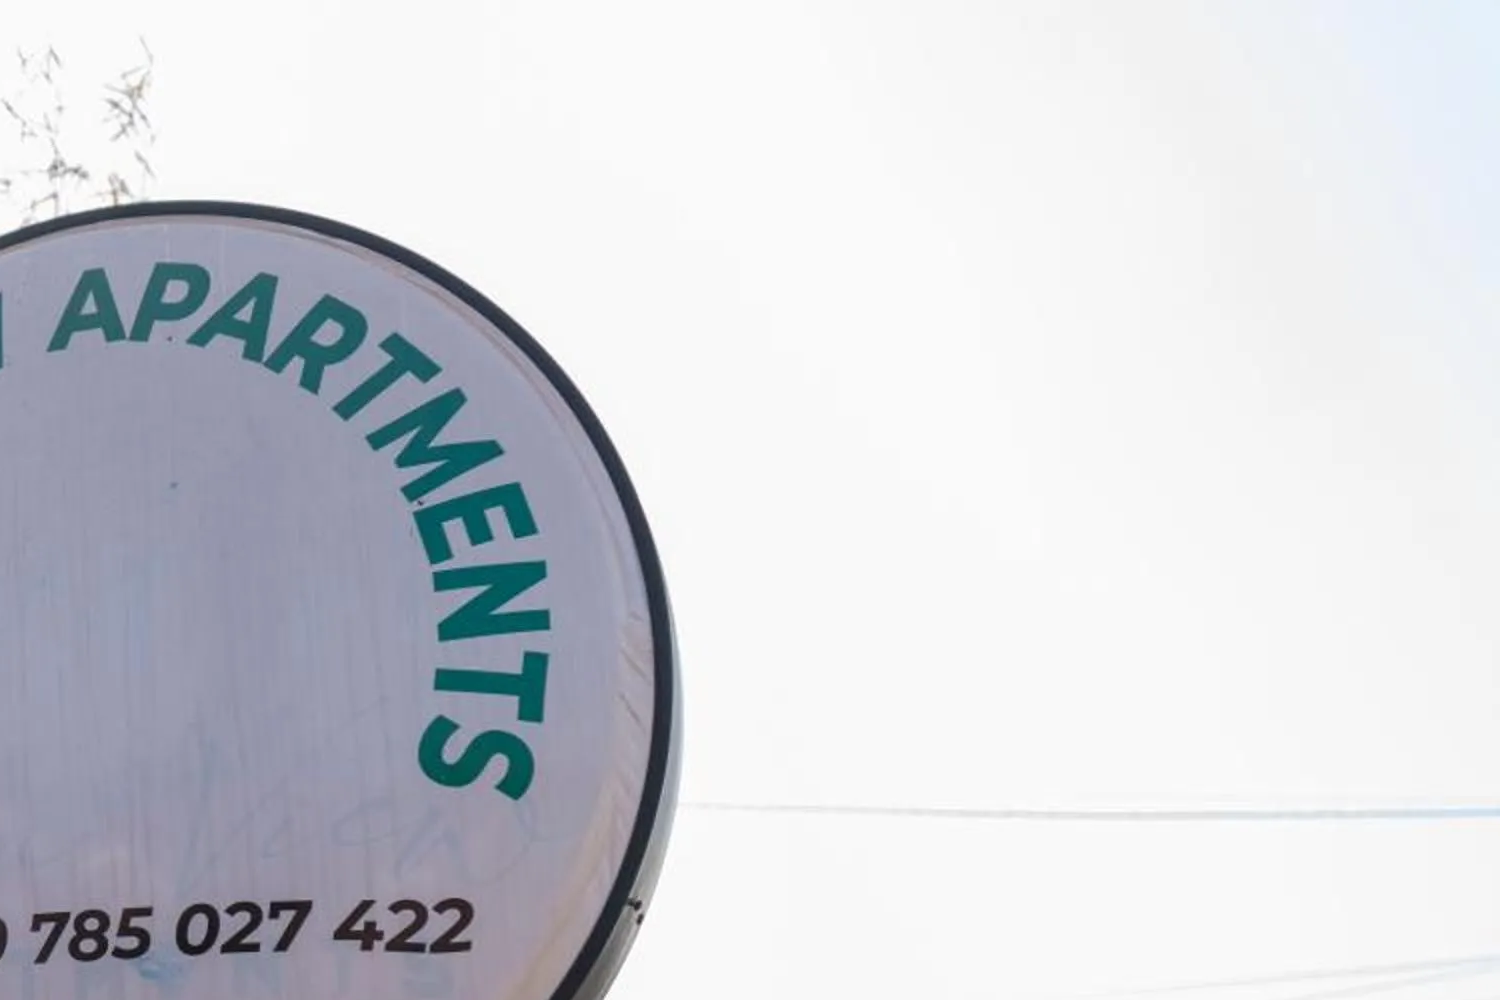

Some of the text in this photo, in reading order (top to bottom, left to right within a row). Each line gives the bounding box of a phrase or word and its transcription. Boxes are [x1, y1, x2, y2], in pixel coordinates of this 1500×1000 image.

[49, 262, 553, 801] APARTMENTS
[29, 904, 155, 966] 785
[175, 899, 314, 957] 027
[332, 896, 475, 955] 422
